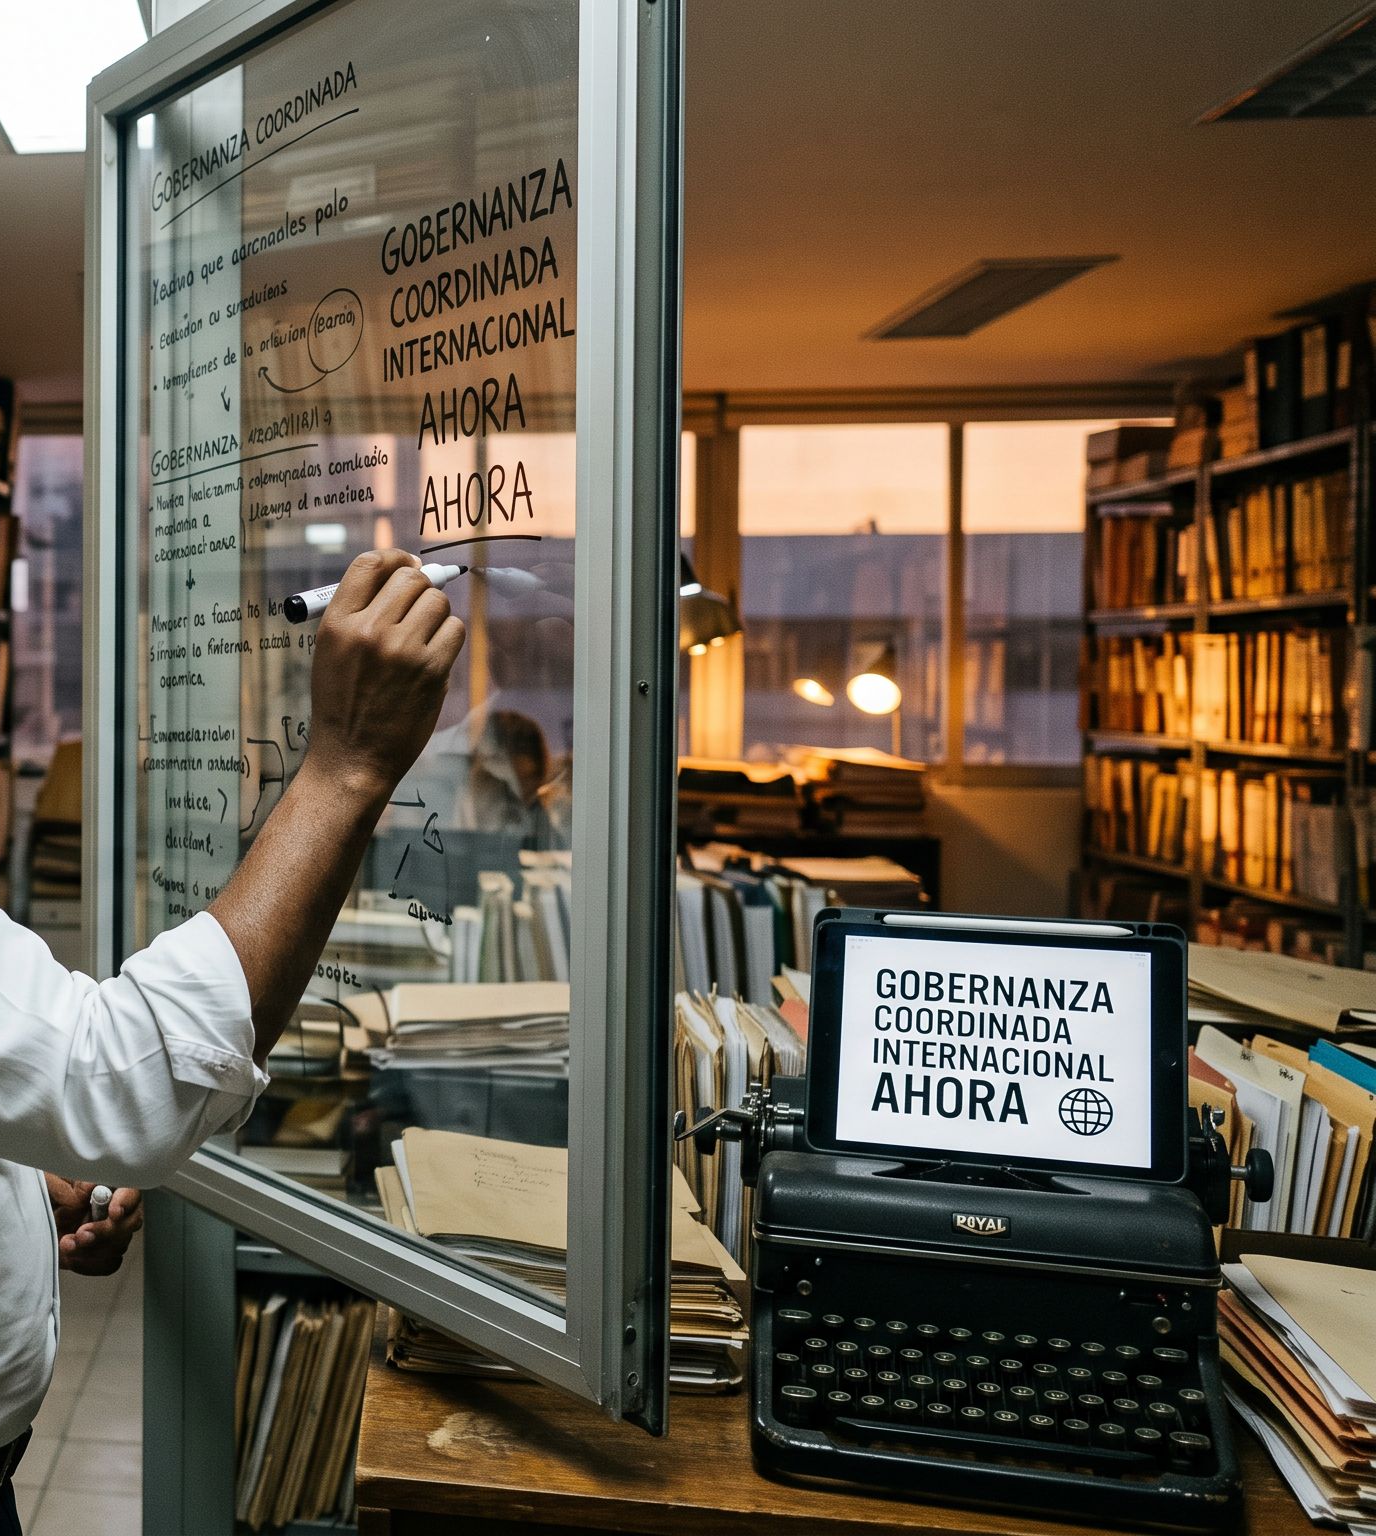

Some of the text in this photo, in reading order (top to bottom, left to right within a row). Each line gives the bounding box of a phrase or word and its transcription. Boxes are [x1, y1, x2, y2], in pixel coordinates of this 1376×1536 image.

[152, 61, 357, 213] GOBERNANZA COORDINADA
[381, 158, 573, 276] GOBERNANZA
[201, 255, 223, 284] que
[390, 237, 558, 328] COORDINADA
[224, 347, 237, 367] de
[383, 297, 575, 382] INTERNACIONAL
[418, 373, 525, 450] AHORA
[420, 460, 534, 536] AHORA
[876, 968, 1114, 1014] GOBERNANZA
[874, 1004, 1072, 1045] COORDINADA
[872, 1037, 1114, 1083] INTERNACIONAL
[871, 1072, 1028, 1125] AHORA
